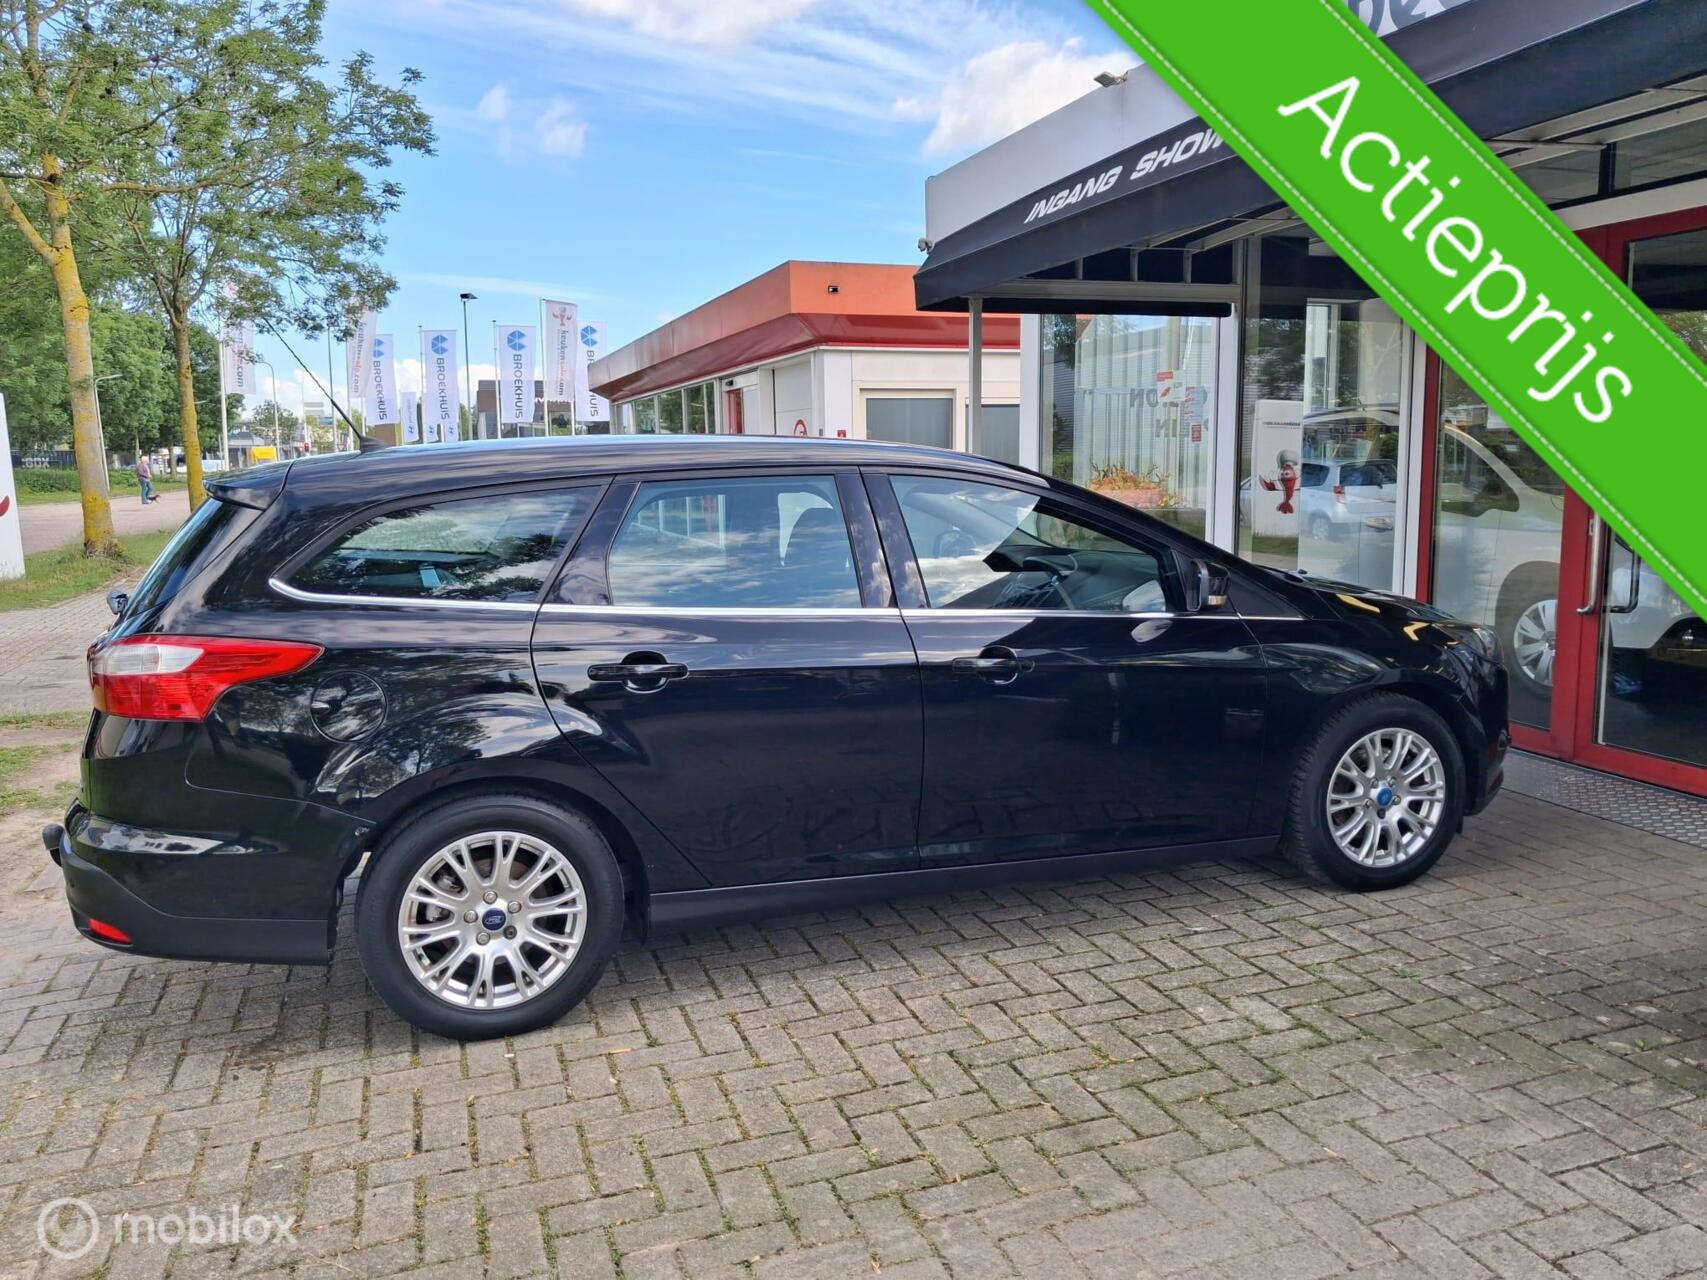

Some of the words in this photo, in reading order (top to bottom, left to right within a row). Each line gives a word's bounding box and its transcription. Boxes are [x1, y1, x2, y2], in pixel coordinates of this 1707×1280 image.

[1024, 165, 1123, 224] INGANG
[373, 360, 388, 421] BROEKHUIS
[436, 357, 450, 420] BROEKHUIS
[513, 353, 524, 420] BROEKHUIS
